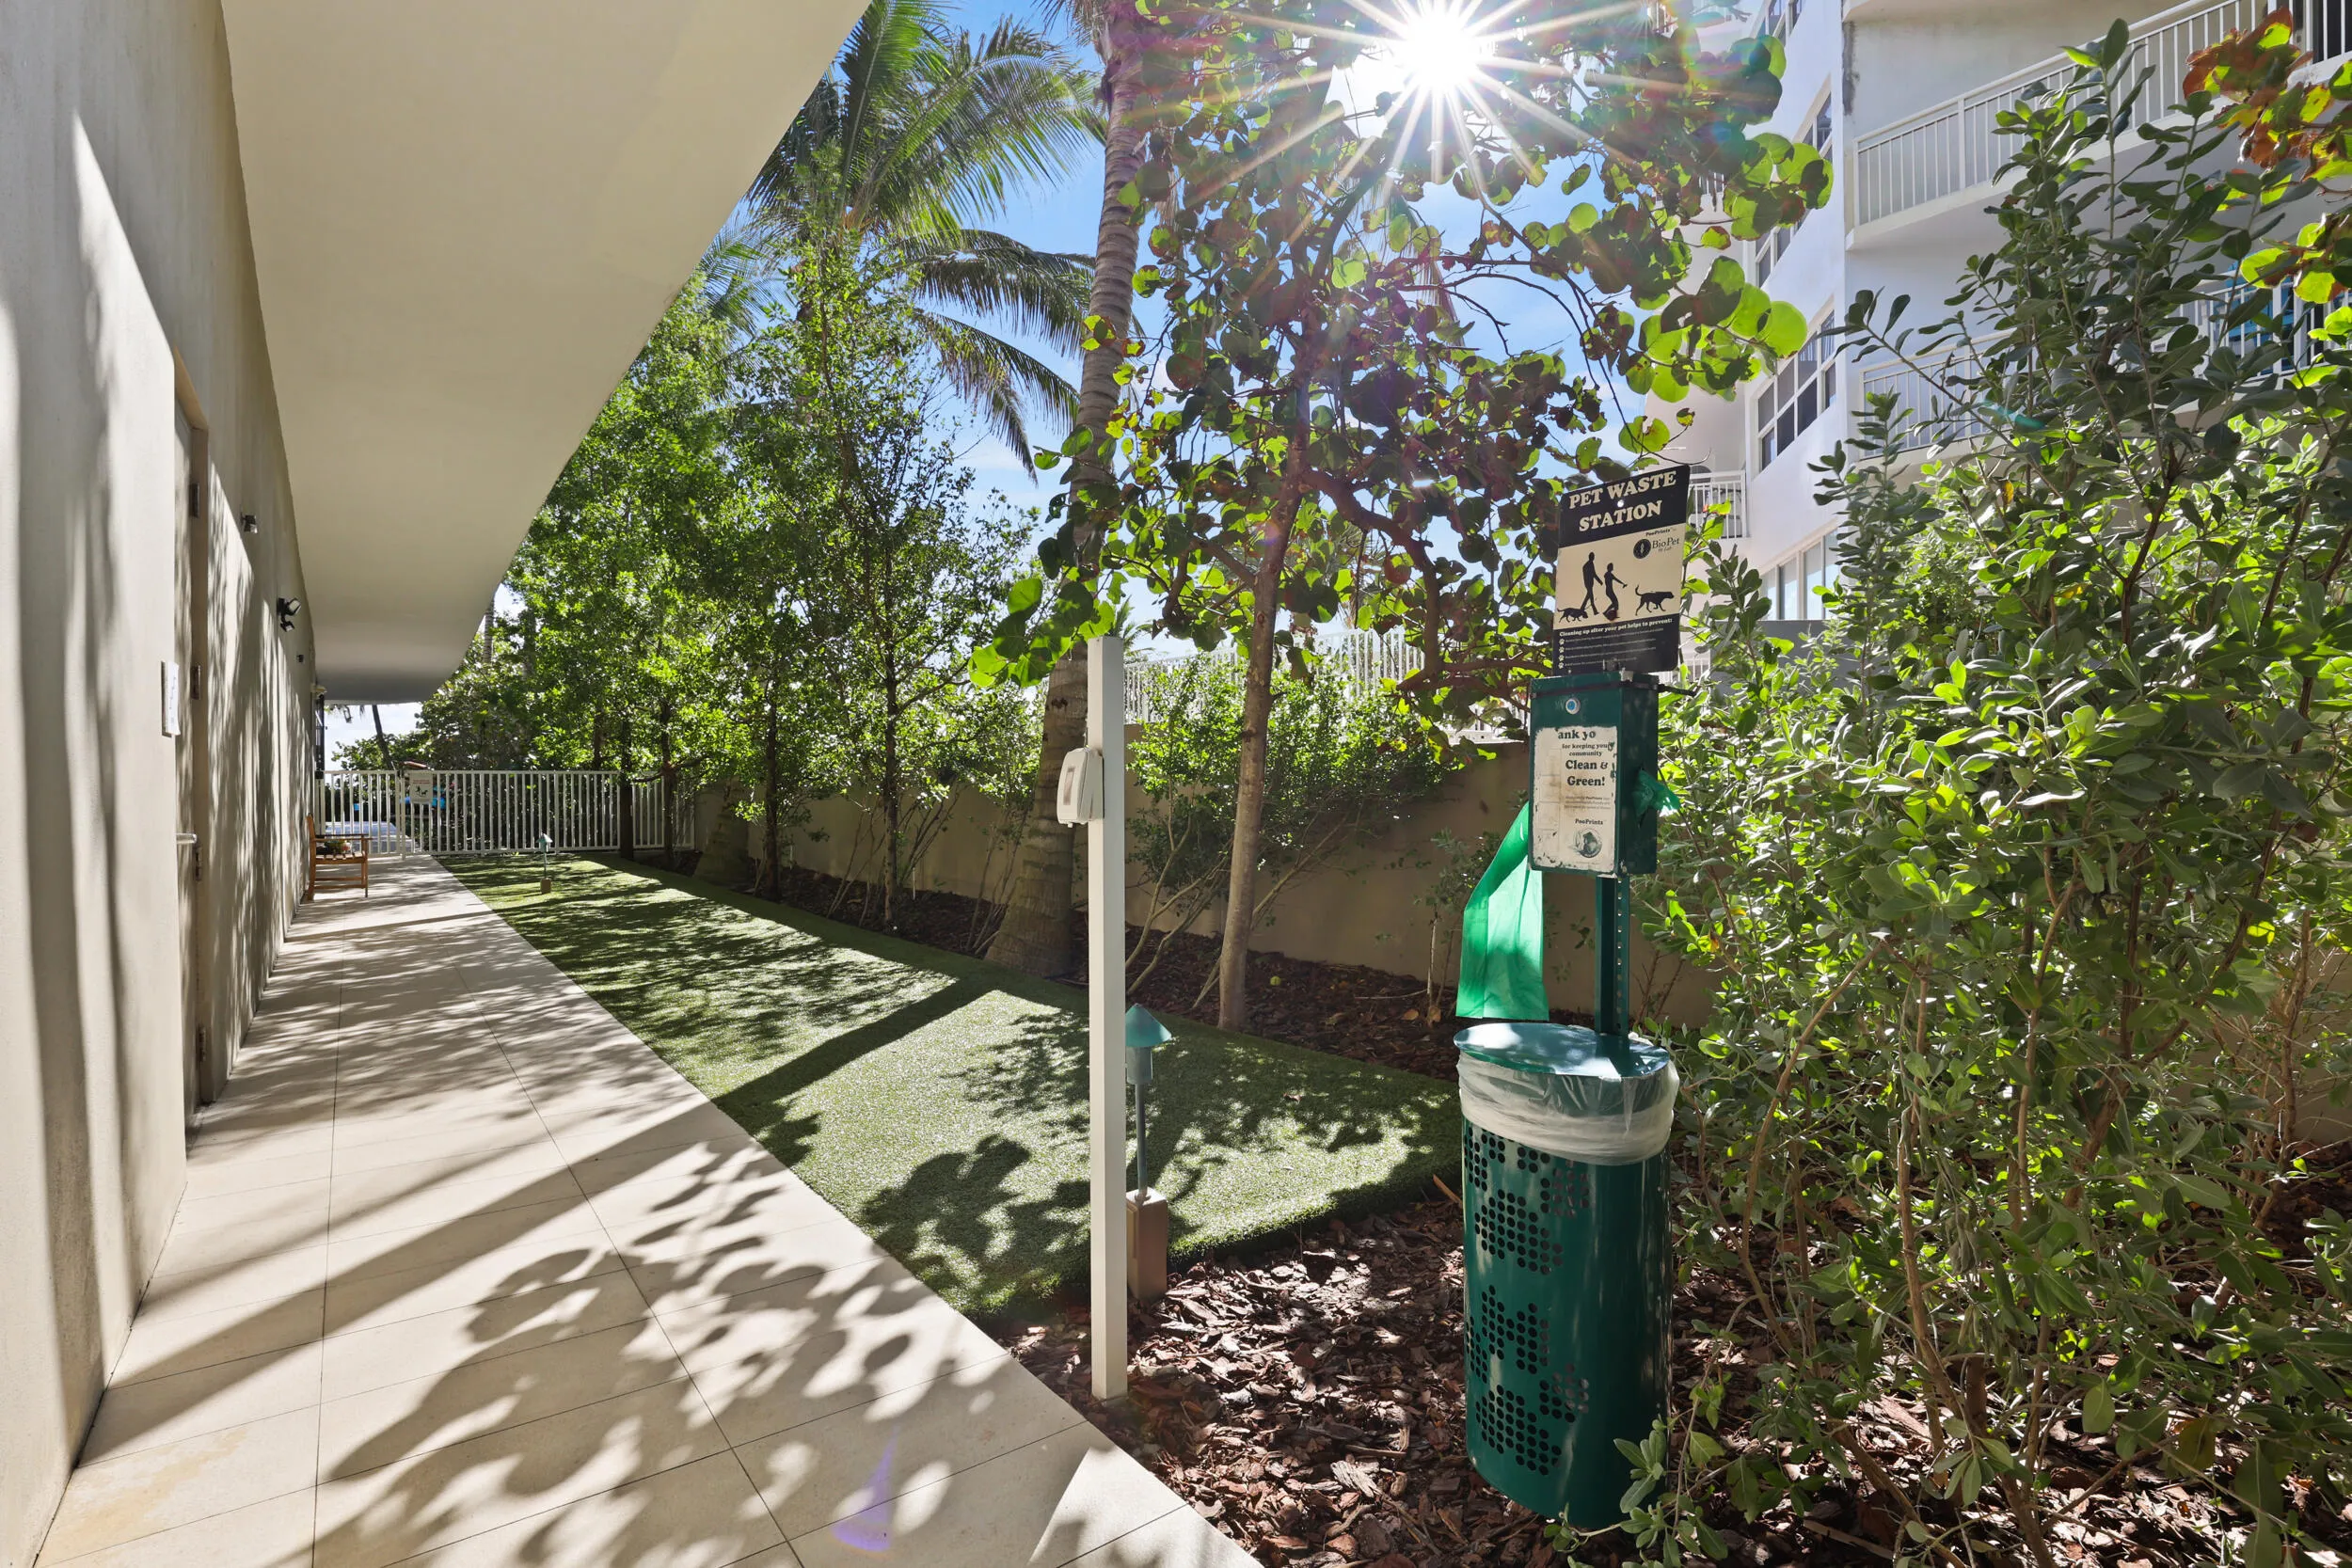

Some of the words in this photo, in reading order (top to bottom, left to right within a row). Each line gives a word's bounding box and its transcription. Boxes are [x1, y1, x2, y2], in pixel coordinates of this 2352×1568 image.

[1569, 488, 1603, 509] PET
[1607, 470, 1677, 499] WASTE
[1579, 500, 1662, 532] STATION
[1648, 618, 1673, 626] prevent:
[1565, 759, 1597, 769] Clean
[1600, 761, 1608, 769] &
[1567, 775, 1605, 786] Green!
